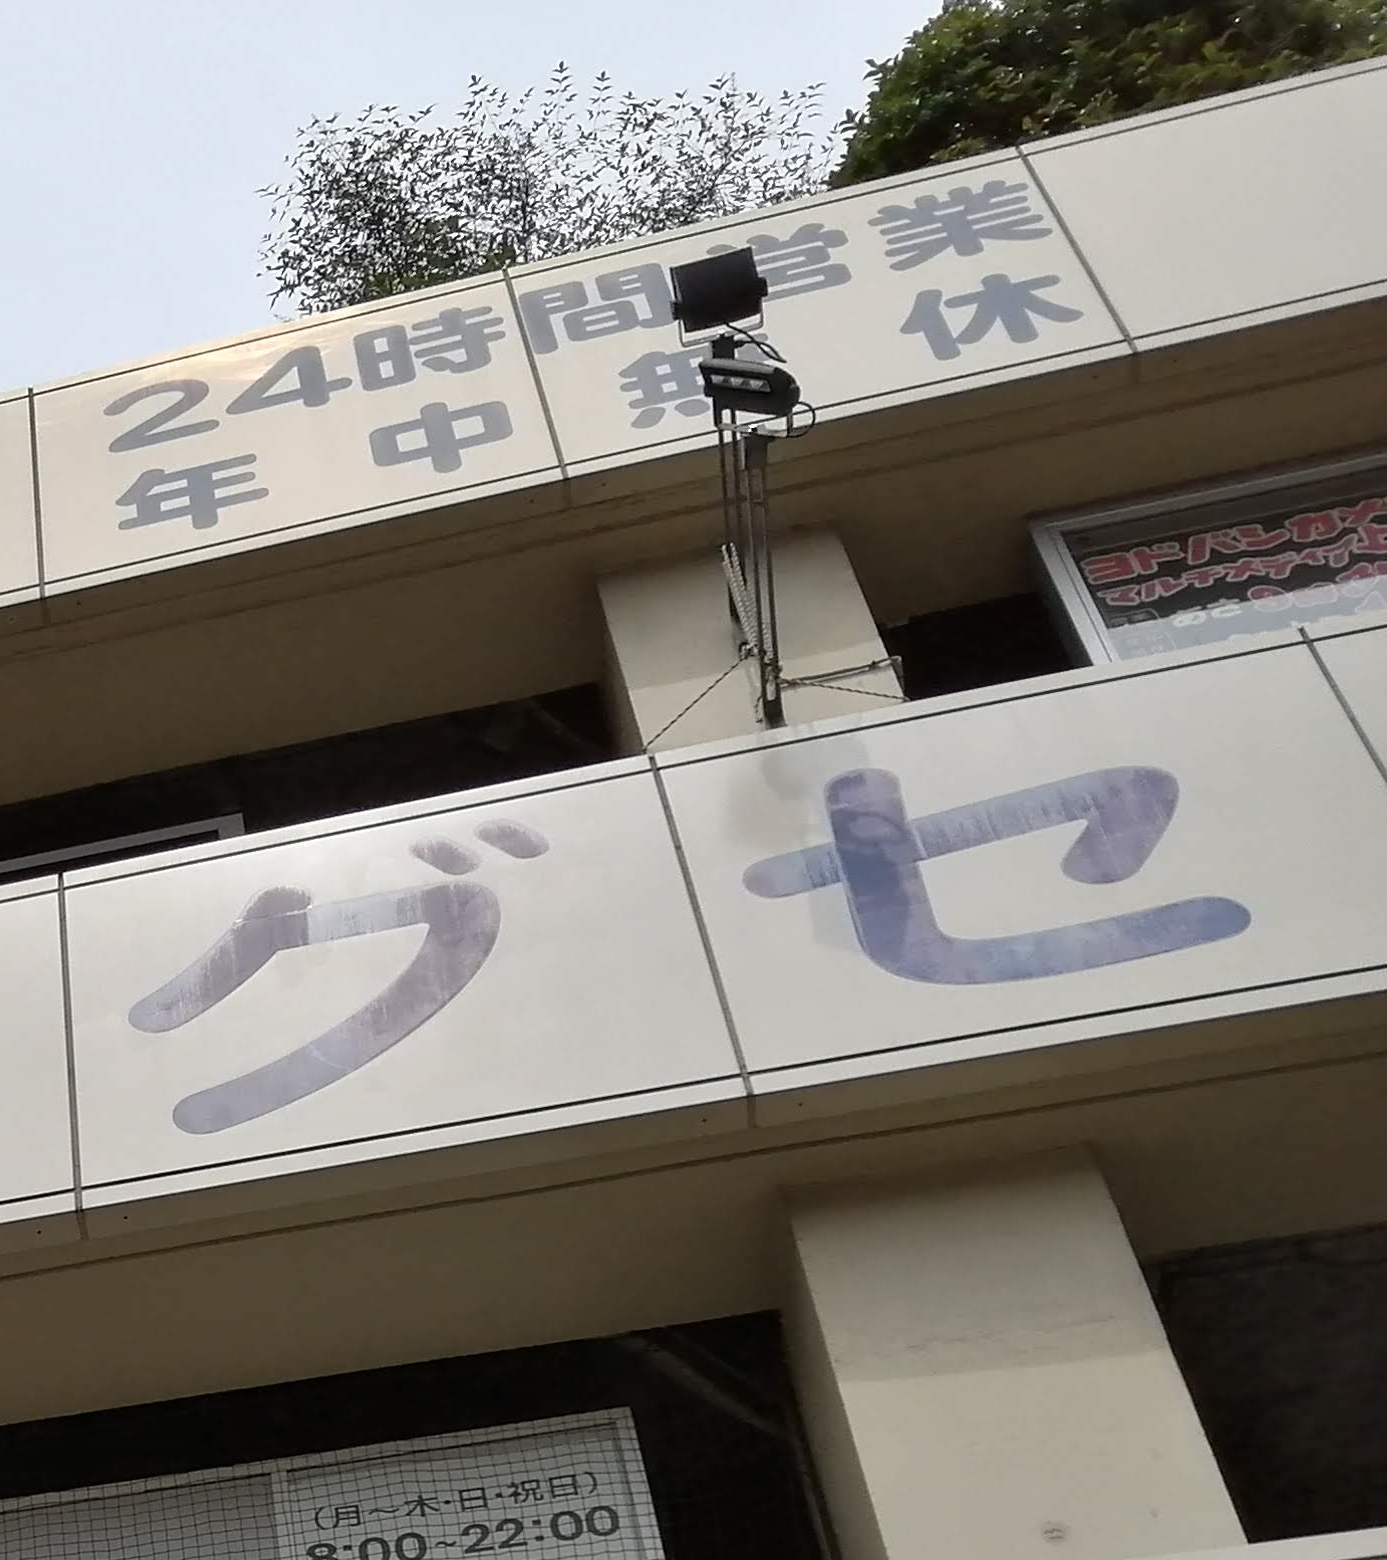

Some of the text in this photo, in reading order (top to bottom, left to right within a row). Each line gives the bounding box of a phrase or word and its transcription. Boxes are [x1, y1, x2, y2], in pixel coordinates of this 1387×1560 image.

[1080, 498, 1387, 585] ヨドバシカメ
